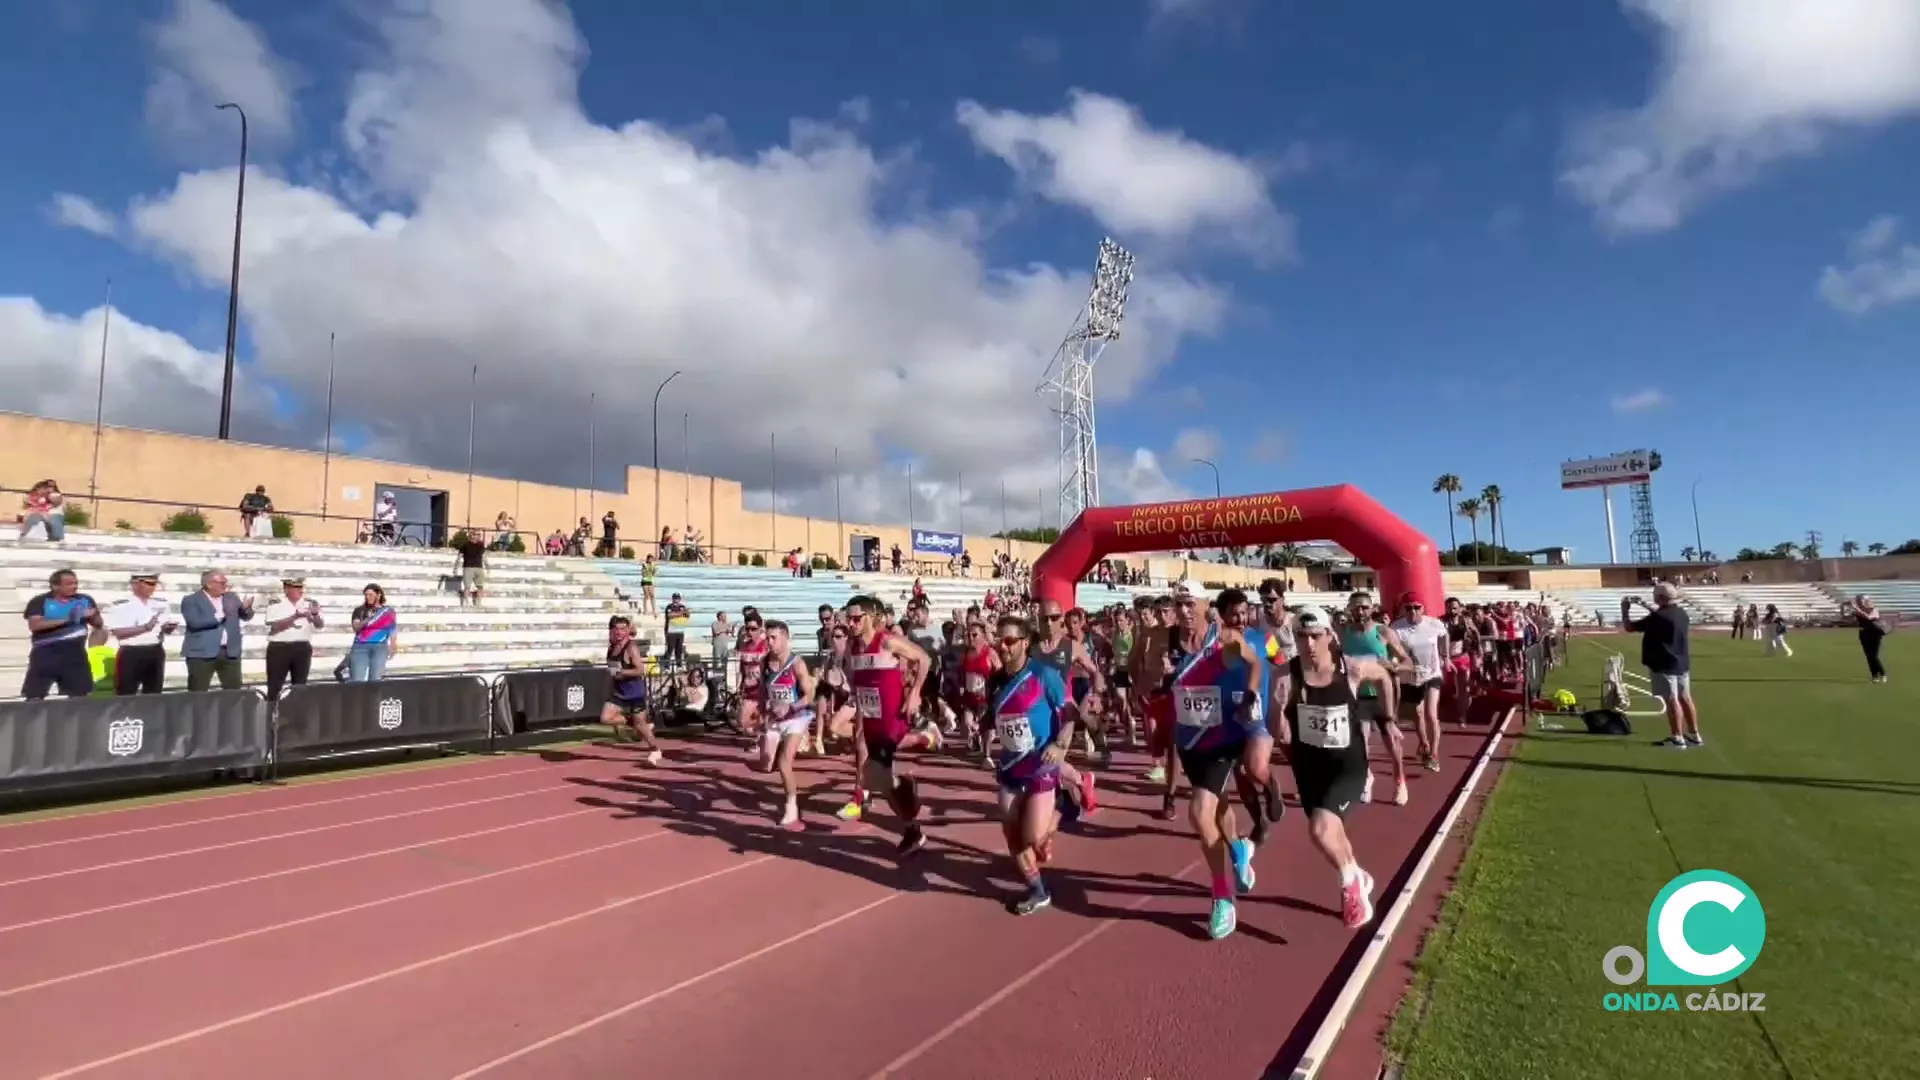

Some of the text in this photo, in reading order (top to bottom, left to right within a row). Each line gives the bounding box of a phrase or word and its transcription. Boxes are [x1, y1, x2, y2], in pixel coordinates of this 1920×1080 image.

[1227, 495, 1282, 508] MARINA
[1113, 505, 1303, 536] TERCIO DE ARMADA
[1178, 531, 1233, 546] META
